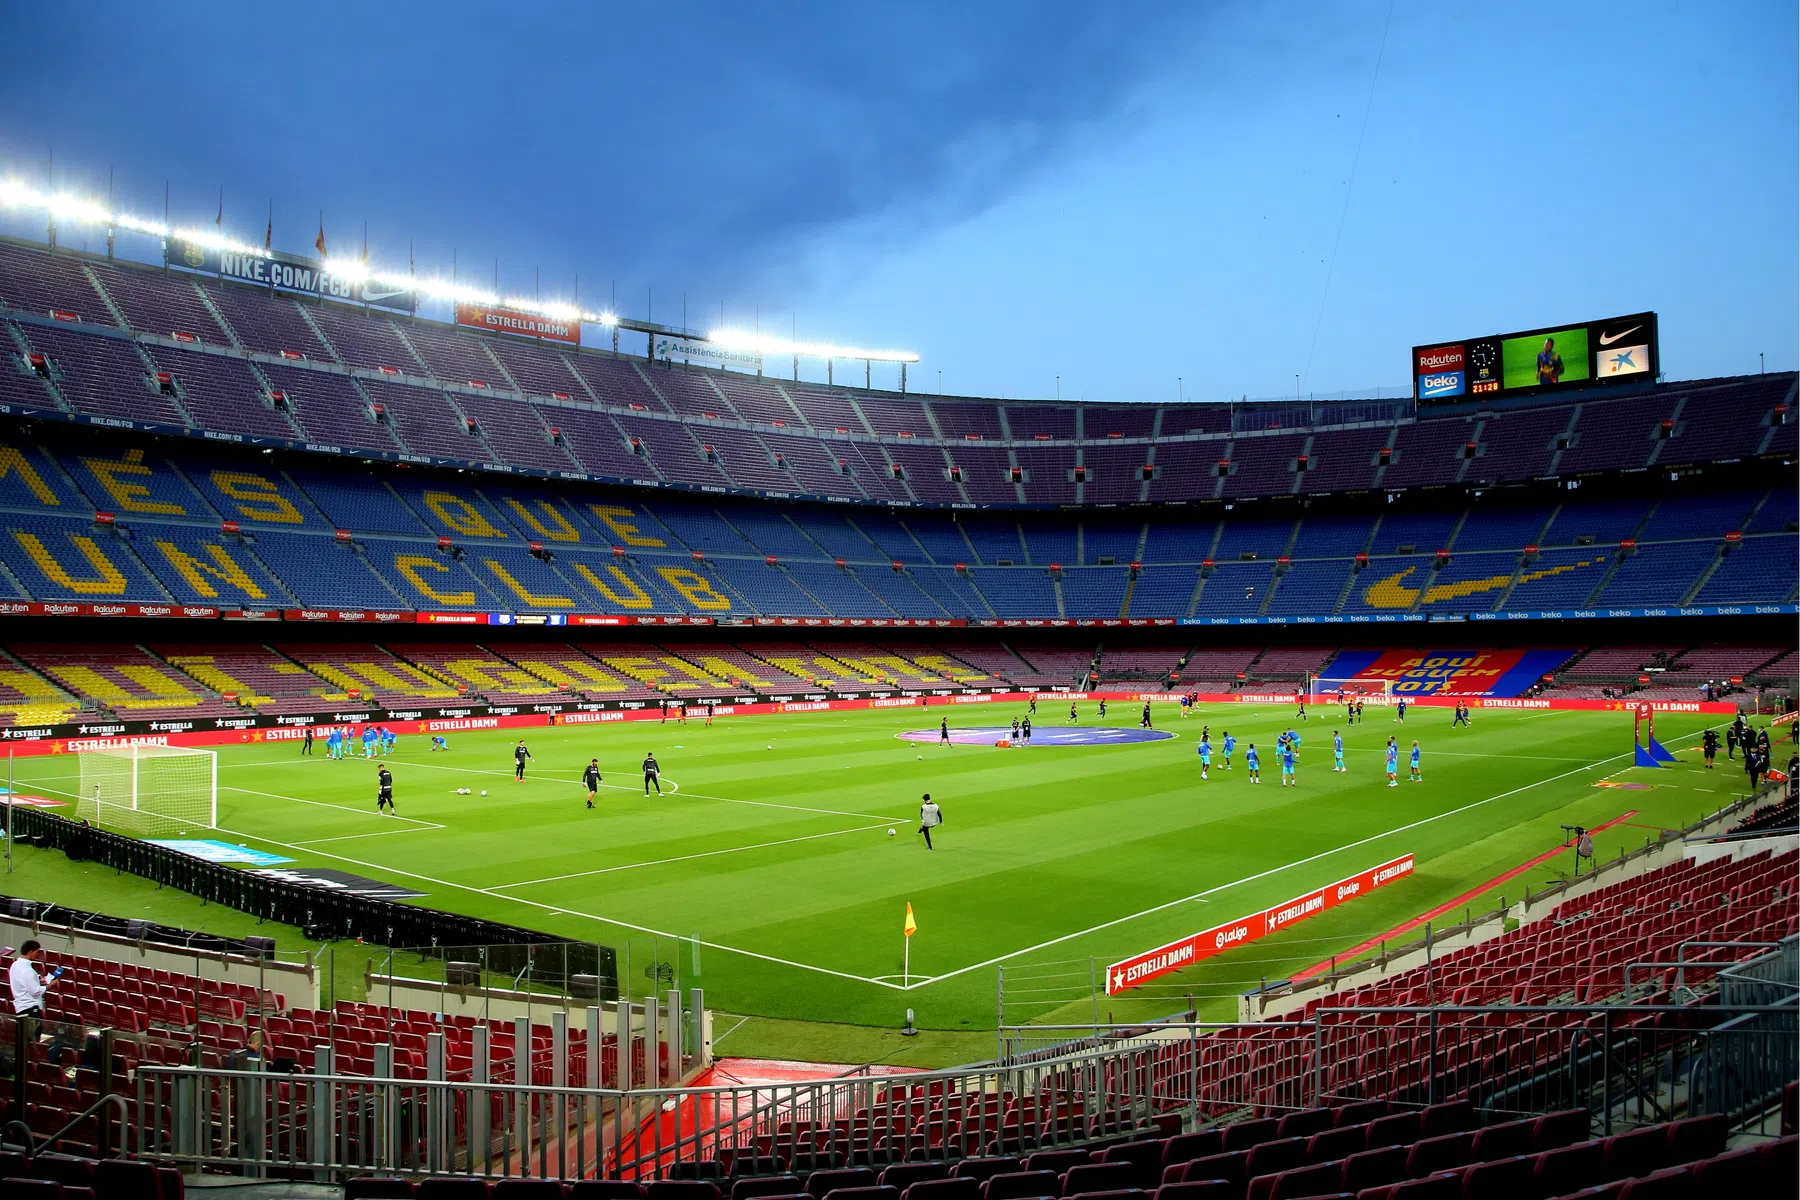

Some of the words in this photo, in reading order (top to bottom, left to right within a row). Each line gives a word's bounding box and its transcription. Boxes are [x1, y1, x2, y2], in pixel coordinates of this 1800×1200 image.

[220, 253, 351, 298] NIKE.COM/FCB
[486, 314, 535, 331] ESTRELLA
[537, 323, 568, 337] DAMM
[1420, 353, 1463, 367] Rakuten
[1424, 376, 1458, 388] beko
[91, 417, 133, 429] NIKE.COM/FCB
[424, 491, 666, 547] QUE
[15, 533, 268, 599] UN
[395, 556, 731, 610] CLUB
[45, 605, 78, 613] Rakuten
[94, 606, 126, 614] Rakuten
[140, 607, 171, 615] Rakuten
[184, 607, 213, 616] Rakuten
[1680, 608, 1703, 616] beko
[1718, 607, 1741, 615] beko
[1755, 606, 1780, 614] beko
[302, 611, 328, 619] Rakuten
[339, 612, 365, 620] Rakuten
[376, 613, 400, 621] Rakuten
[1400, 655, 1491, 668] AQUÍ
[1362, 669, 1501, 677] JUGUEM
[785, 703, 811, 711] ESTRELLA
[1483, 699, 1522, 707] ESTRELLA
[1524, 700, 1549, 708] DAMM
[1626, 702, 1669, 711] ESTLLA
[1670, 703, 1699, 711] DAMM
[714, 707, 734, 715] DAMM
[285, 716, 314, 724] ESTRELLA
[342, 713, 369, 721] ESTRELLA
[565, 713, 599, 723] ESTRELLA
[601, 712, 623, 720] DAMM
[160, 721, 193, 730] ESTRELLA
[225, 719, 256, 727] ESTRELLA
[430, 720, 470, 731] ESTRELLA
[472, 718, 498, 728] DAMM
[13, 729, 52, 738] ESTRELLA
[89, 725, 125, 733] ESTRELLA
[68, 737, 128, 751] ESTRELLA
[1379, 865, 1400, 882] ESTRELLA
[1400, 858, 1413, 874] DAMM
[1343, 882, 1359, 897] LaLiga
[1277, 903, 1304, 925] ESTRELLA
[1305, 895, 1322, 914] DAMM
[1225, 926, 1247, 943] LaLiga
[1127, 956, 1167, 982] ESTRELLA
[1168, 944, 1193, 967] DAMM
